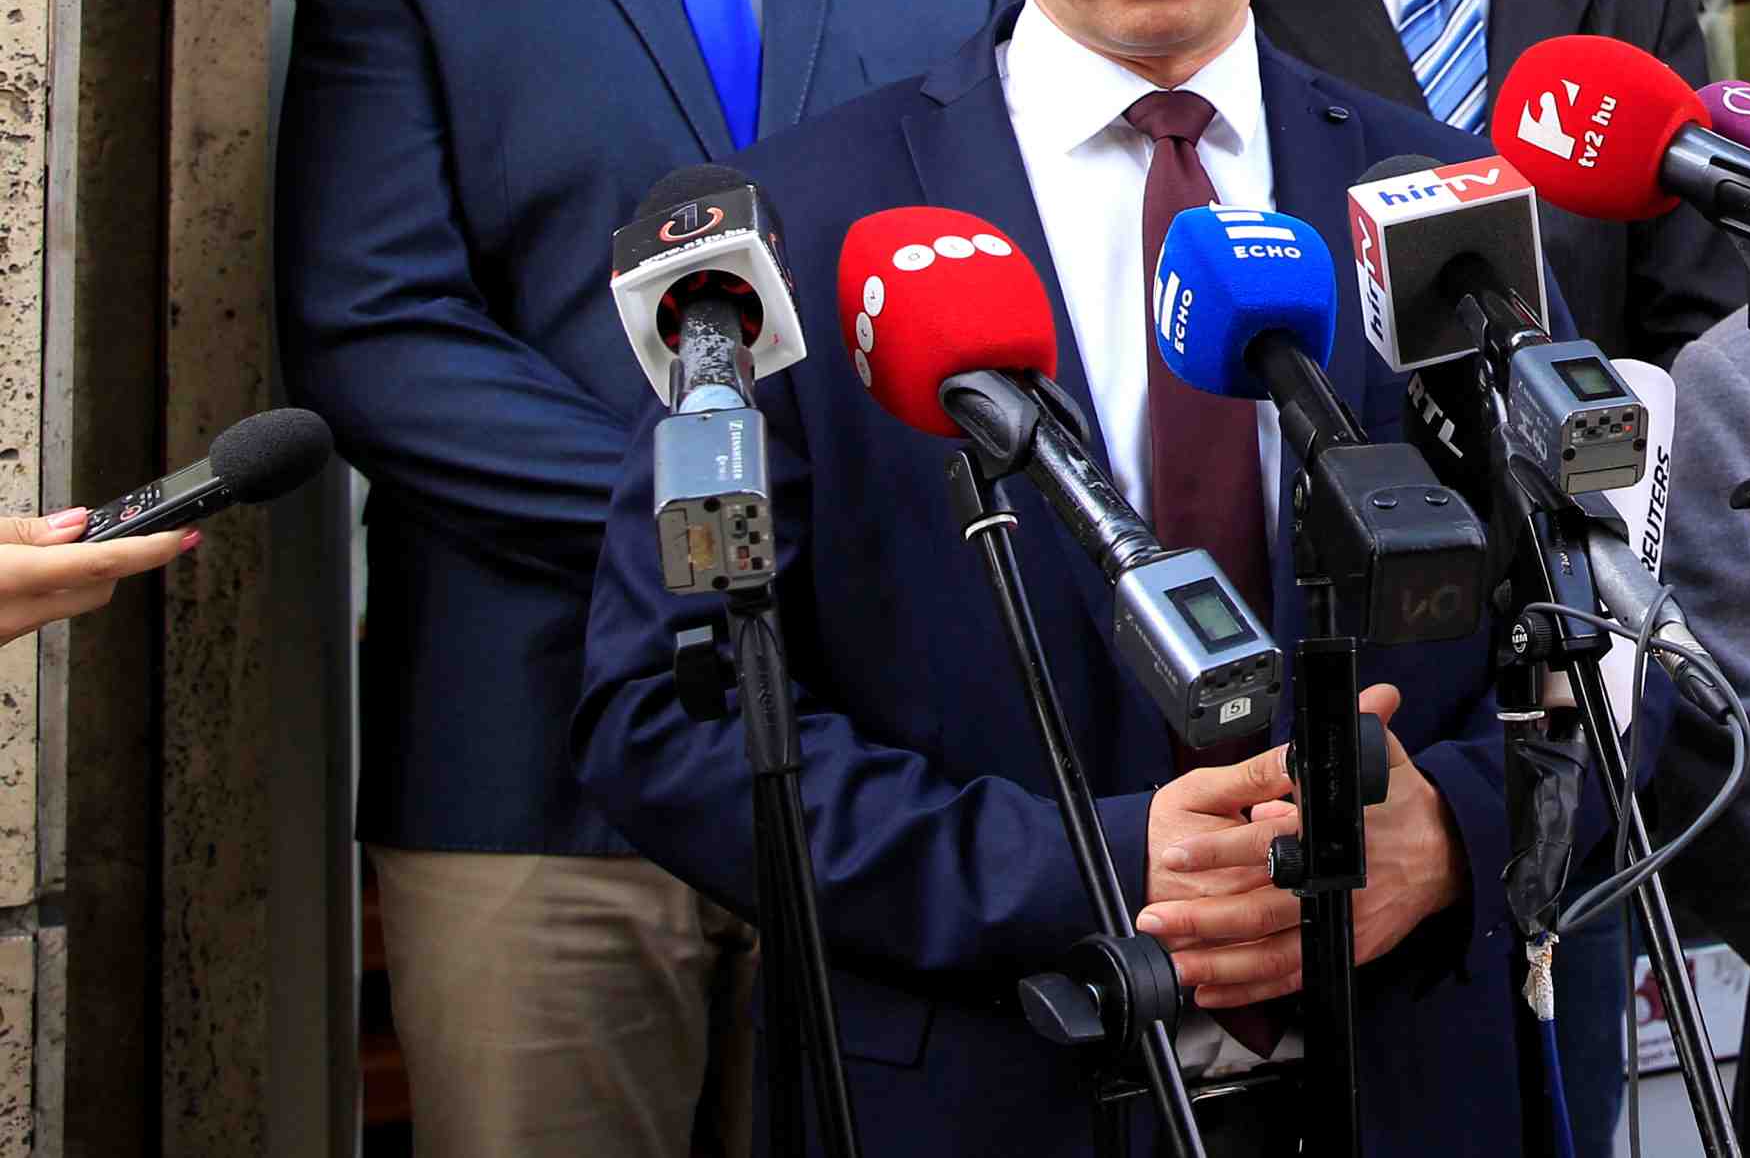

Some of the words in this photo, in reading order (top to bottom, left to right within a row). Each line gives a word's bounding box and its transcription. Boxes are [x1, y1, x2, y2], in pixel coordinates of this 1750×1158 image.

[1233, 245, 1302, 259] ECHO
[1174, 289, 1193, 355] ECHO
[1230, 701, 1240, 714] 5
